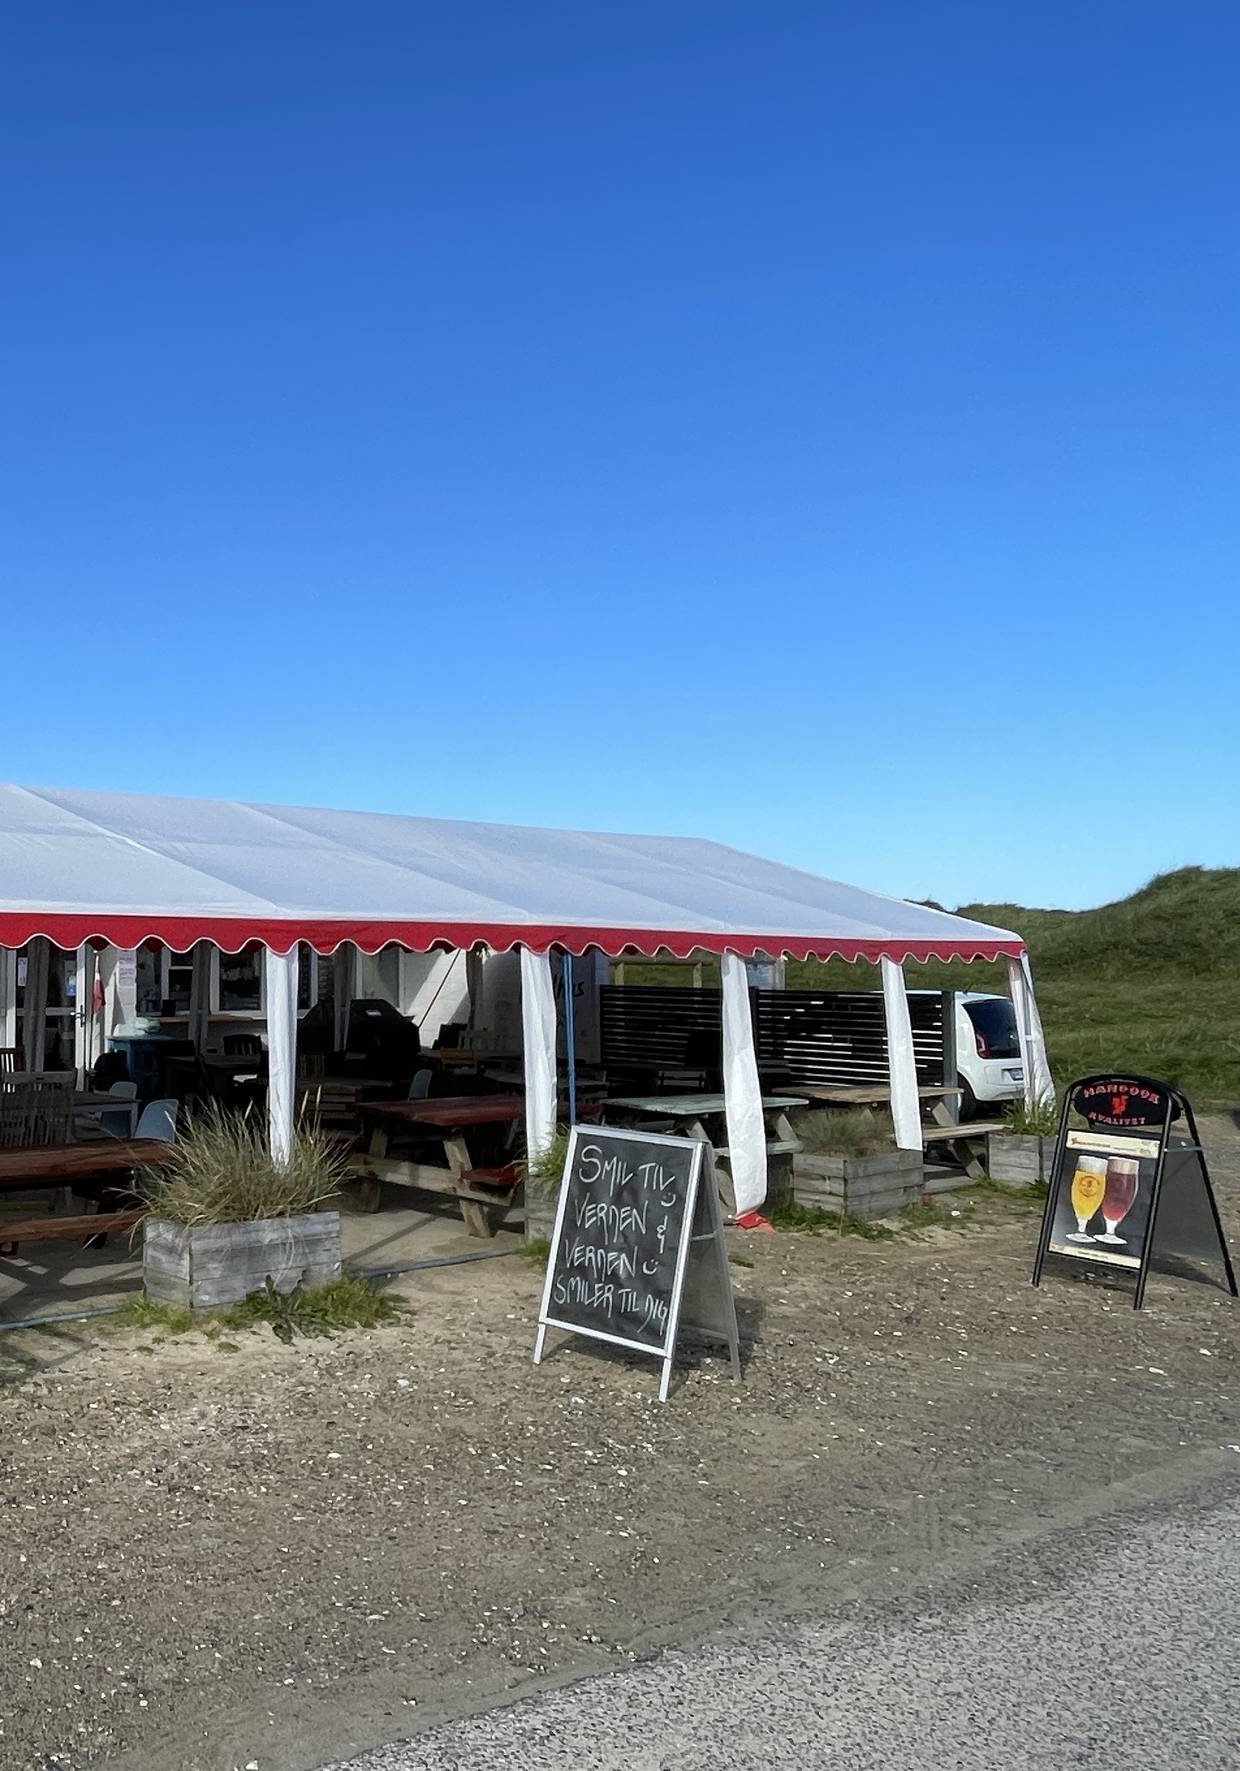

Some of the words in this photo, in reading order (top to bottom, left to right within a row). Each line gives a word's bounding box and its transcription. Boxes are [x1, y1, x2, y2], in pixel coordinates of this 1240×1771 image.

[639, 1162, 675, 1191] TIL
[554, 1275, 613, 1318] SMILER
[618, 1288, 640, 1313] TIL
